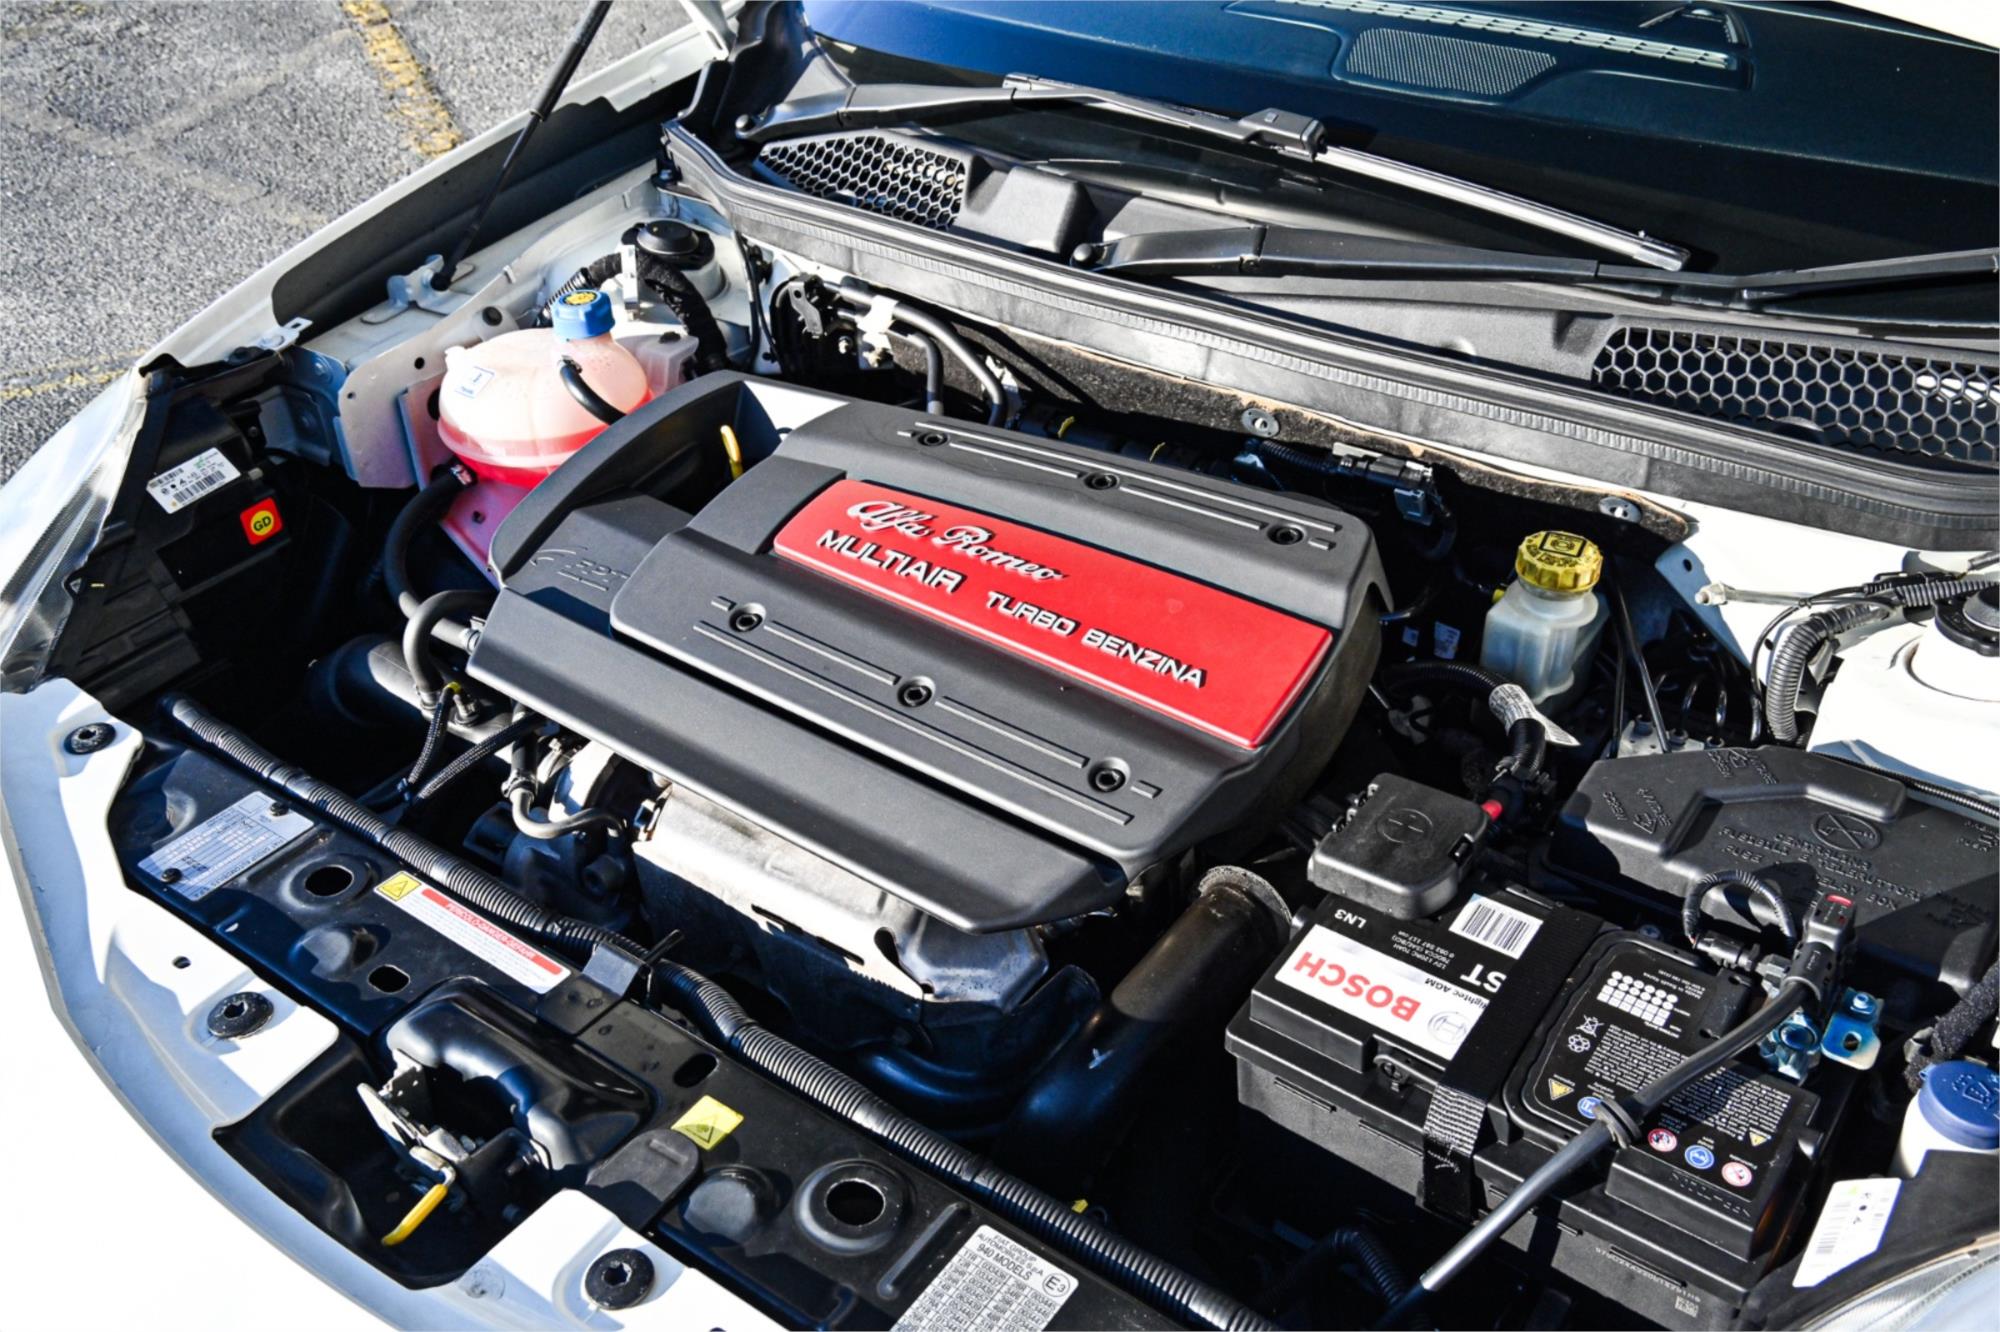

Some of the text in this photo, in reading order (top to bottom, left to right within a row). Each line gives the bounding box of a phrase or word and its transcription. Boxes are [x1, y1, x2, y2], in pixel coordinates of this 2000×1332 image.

[253, 516, 272, 531] GD
[847, 501, 1067, 583] Alfa Romeo
[817, 529, 967, 593] MULTIAIR
[987, 590, 1208, 688] TURBO BENZINA
[1334, 908, 1367, 929] LN3
[1294, 951, 1421, 1022] BOSCH
[1423, 977, 1451, 993] AGM
[1460, 963, 1507, 994] ST
[975, 1242, 1032, 1280] 940 MODELS
